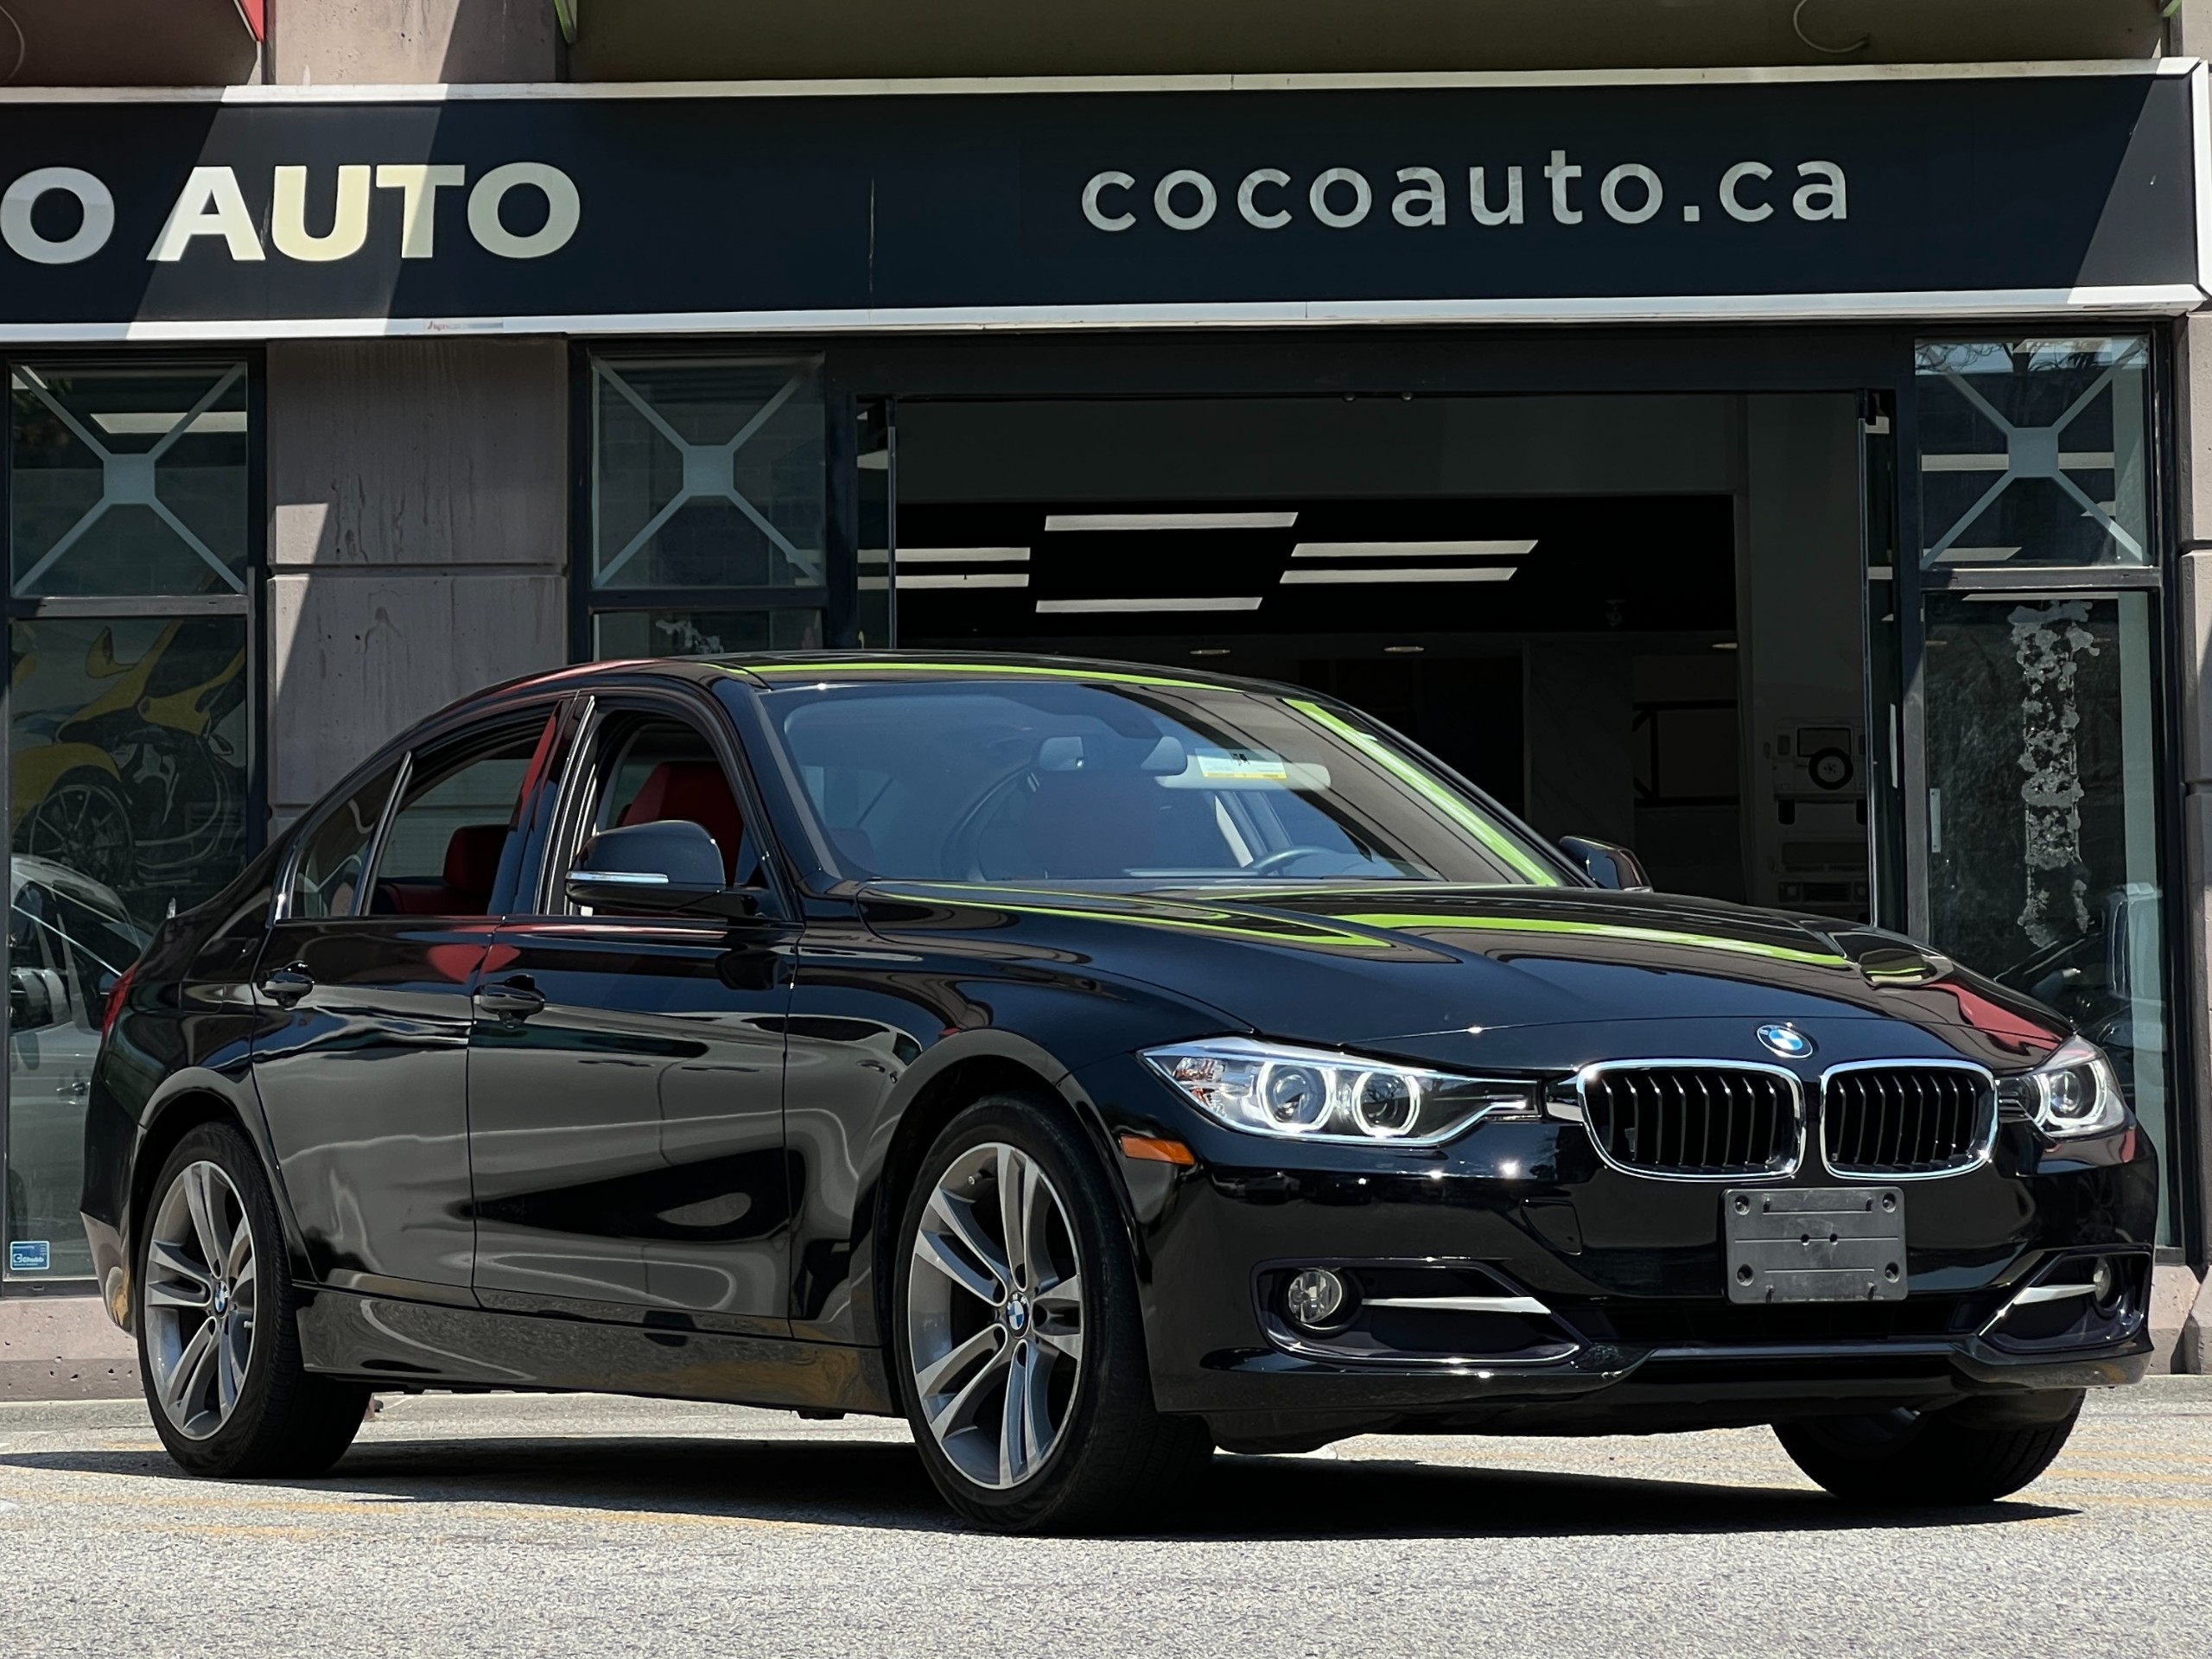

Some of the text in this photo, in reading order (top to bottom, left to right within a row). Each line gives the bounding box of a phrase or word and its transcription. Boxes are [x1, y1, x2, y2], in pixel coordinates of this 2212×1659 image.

[0, 162, 581, 264] O AUTO
[1081, 149, 1847, 231] cocoauto.ca
